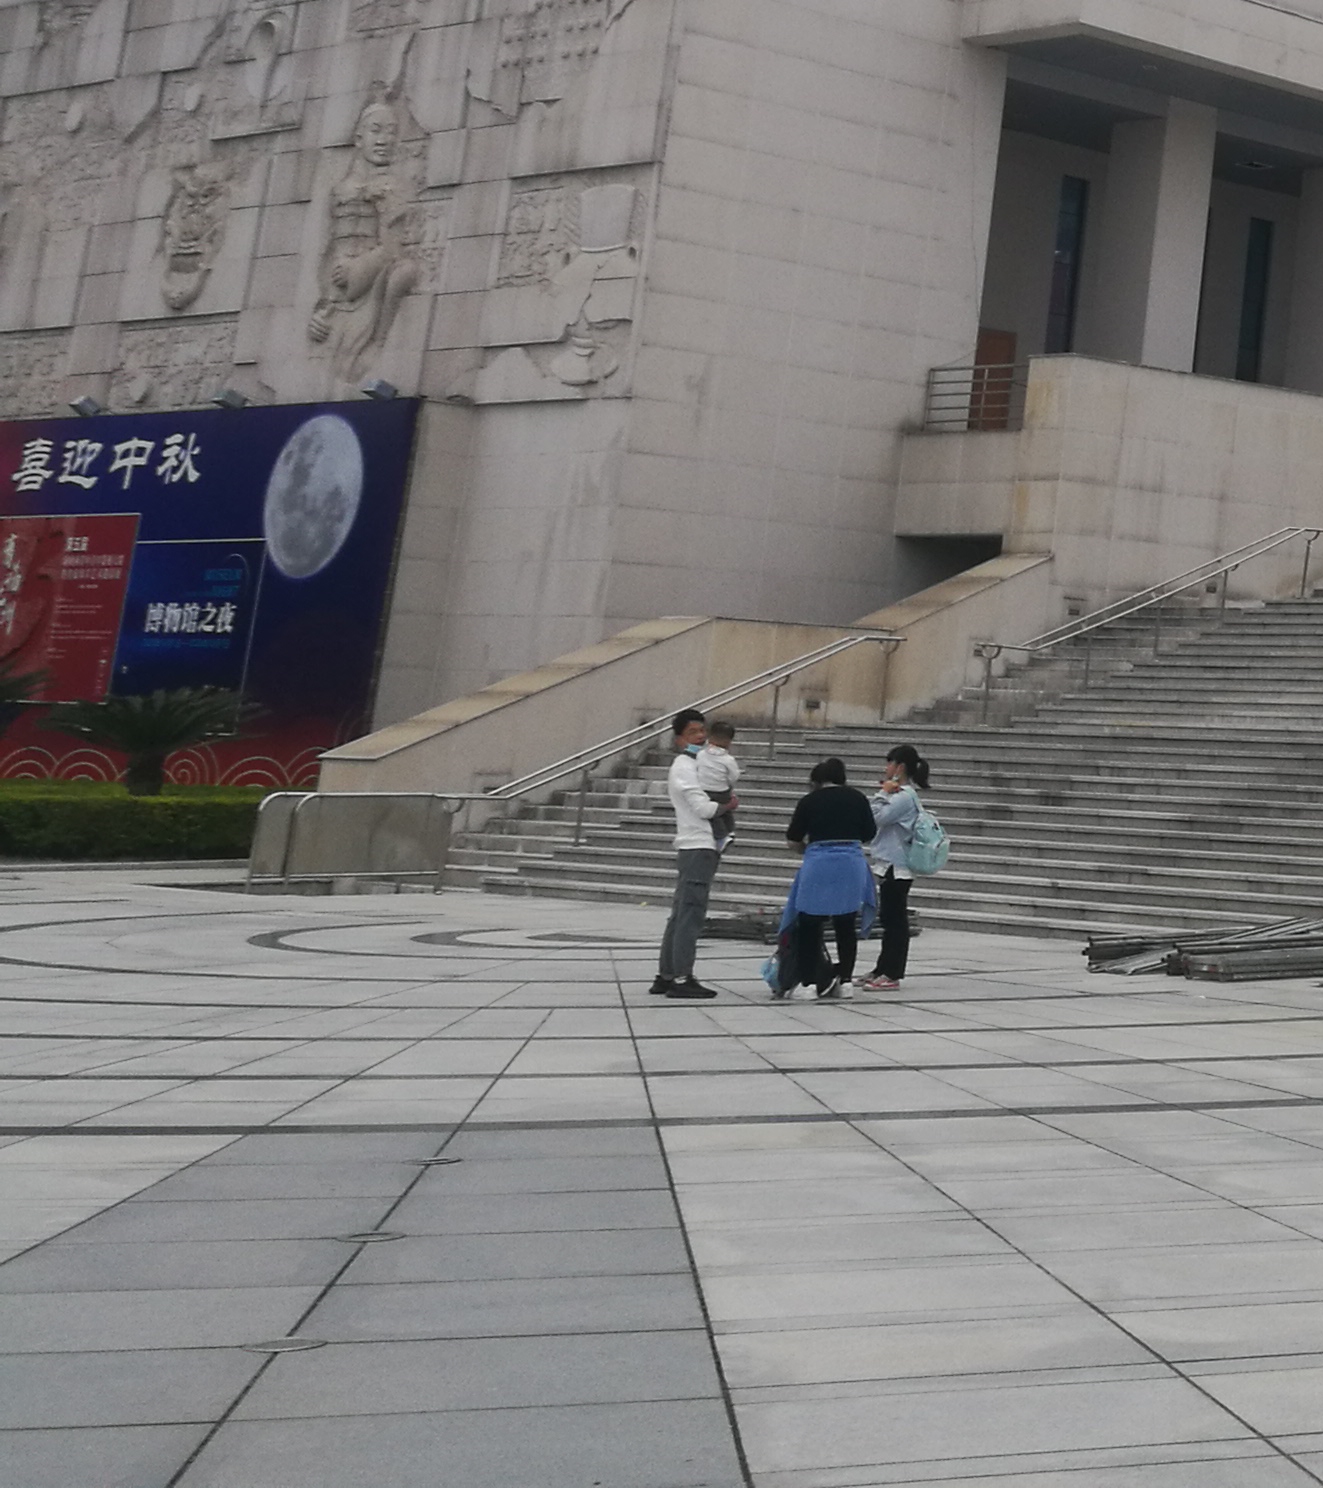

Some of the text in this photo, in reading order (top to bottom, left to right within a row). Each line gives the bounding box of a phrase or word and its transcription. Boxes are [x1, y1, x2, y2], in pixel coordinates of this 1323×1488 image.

[11, 432, 202, 493] 喜迎中秋
[144, 602, 238, 633] 博物馆之夜
